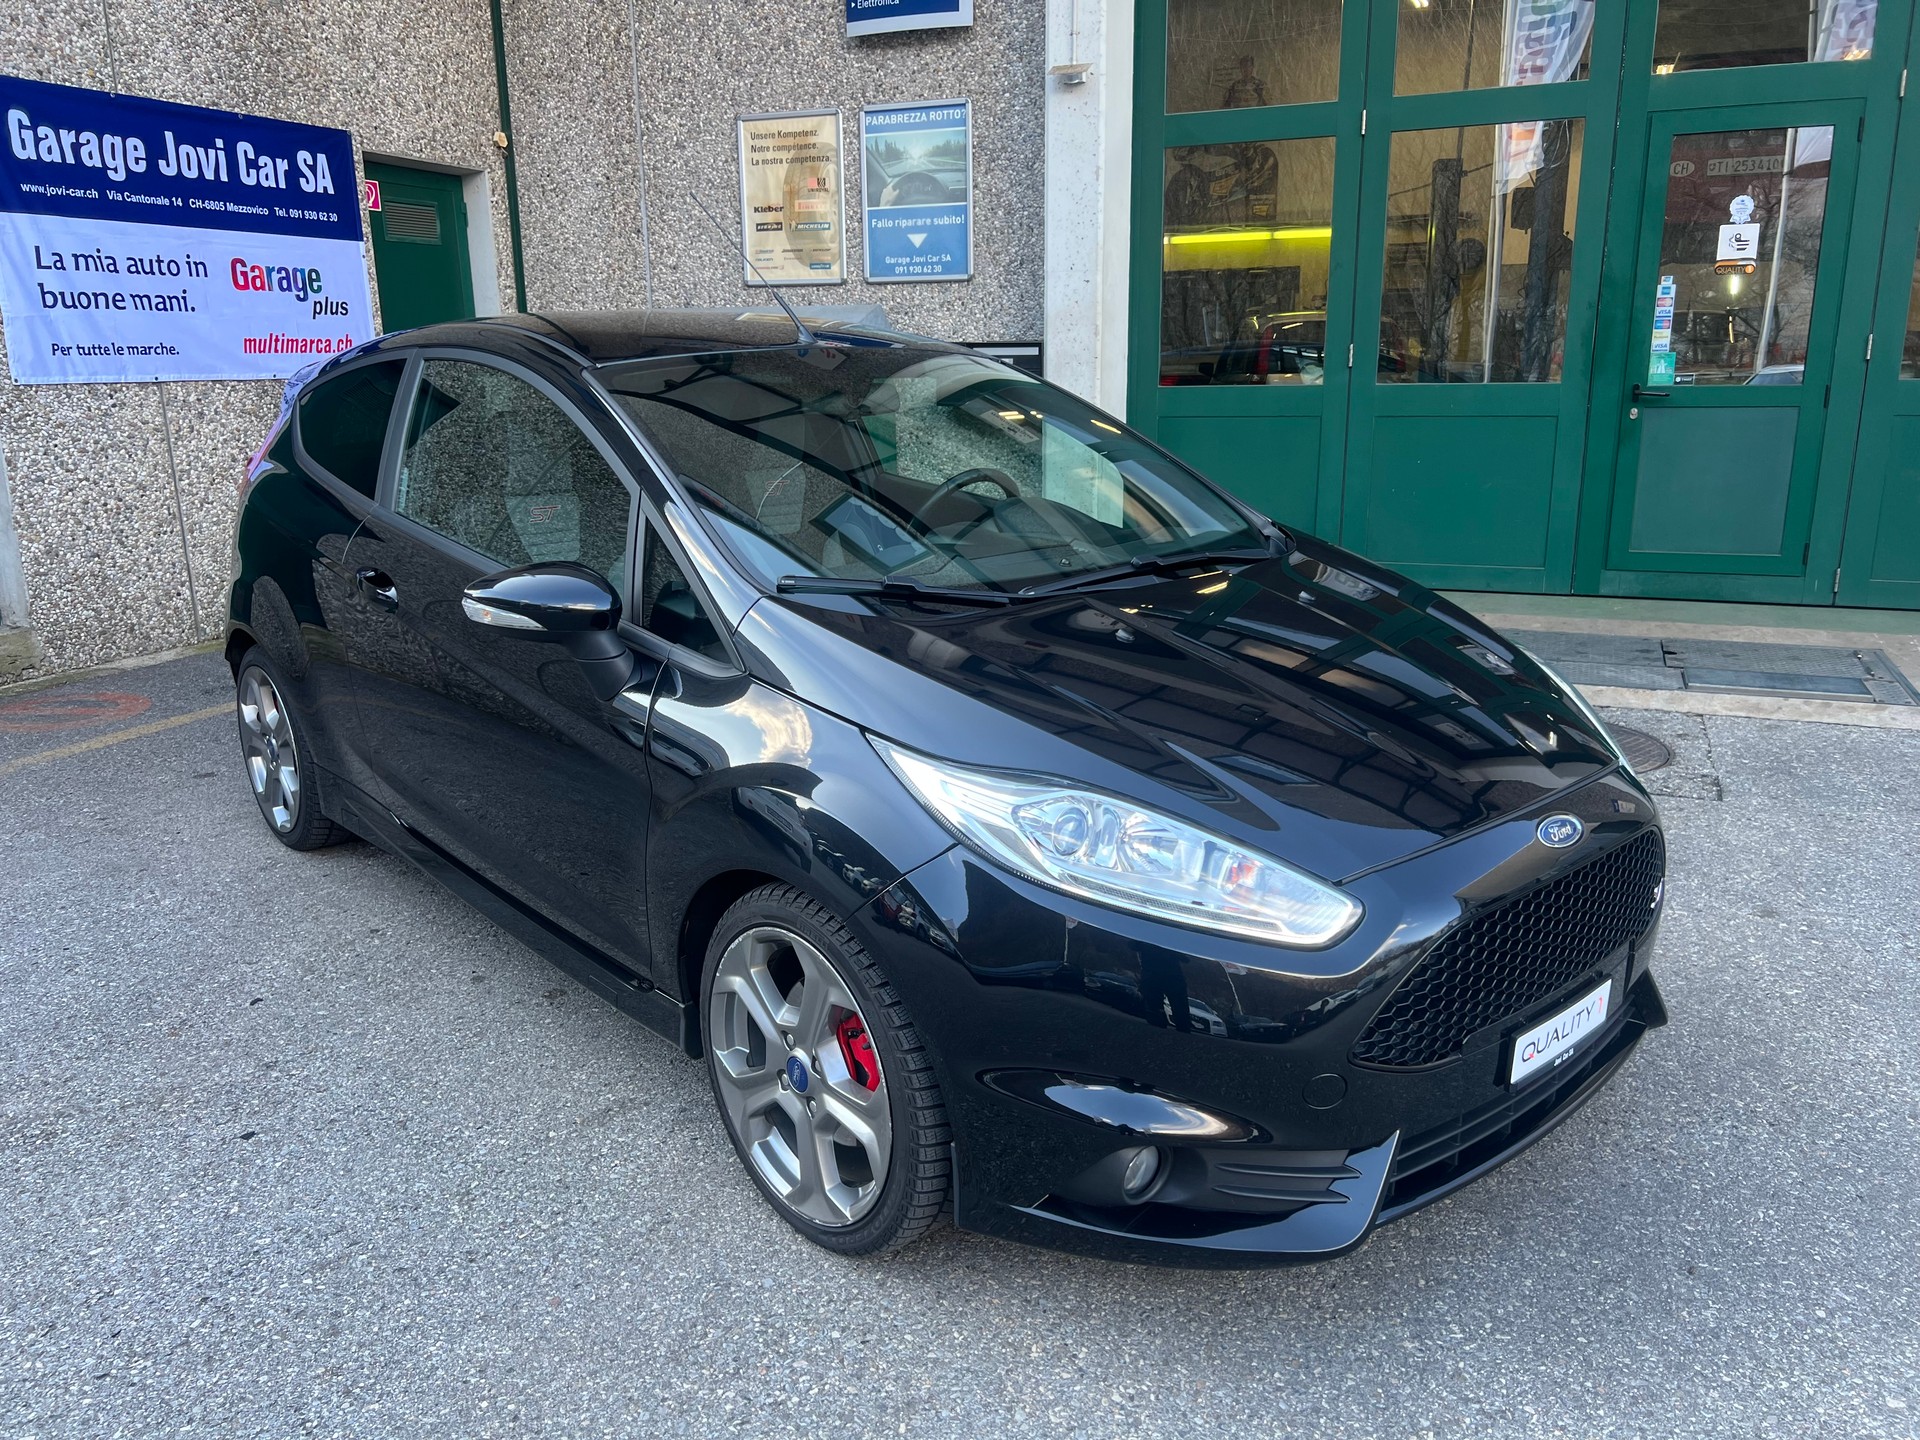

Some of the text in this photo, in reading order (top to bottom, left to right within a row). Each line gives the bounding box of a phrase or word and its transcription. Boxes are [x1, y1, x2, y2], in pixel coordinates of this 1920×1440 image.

[865, 109, 966, 126] PARABREZZA ROTTO?
[750, 131, 776, 140] Unsere
[7, 109, 335, 195] Garage Jovi Car SA
[750, 144, 771, 153] Notre
[751, 154, 832, 166] La nostra competenza.
[1673, 163, 1690, 175] CH
[20, 183, 338, 222] www.jovi-car.ch Via Cantonale 14 CH-6805 Mezzovico Tel. 091 930 62 30
[871, 214, 965, 228] Fallo riparare subito!
[34, 245, 209, 278] La mia auto in
[885, 253, 952, 265] Garage Jovi Car SA
[895, 266, 908, 274] 091
[909, 265, 922, 273] 930
[933, 264, 942, 272] 30
[230, 257, 323, 302] Garage
[37, 282, 196, 313] buone mani.
[312, 296, 349, 320] plus
[51, 342, 180, 356] Per tutte le marche.
[243, 332, 353, 354] multimarca.ch
[529, 505, 561, 523] ST
[1548, 821, 1573, 841] Ford
